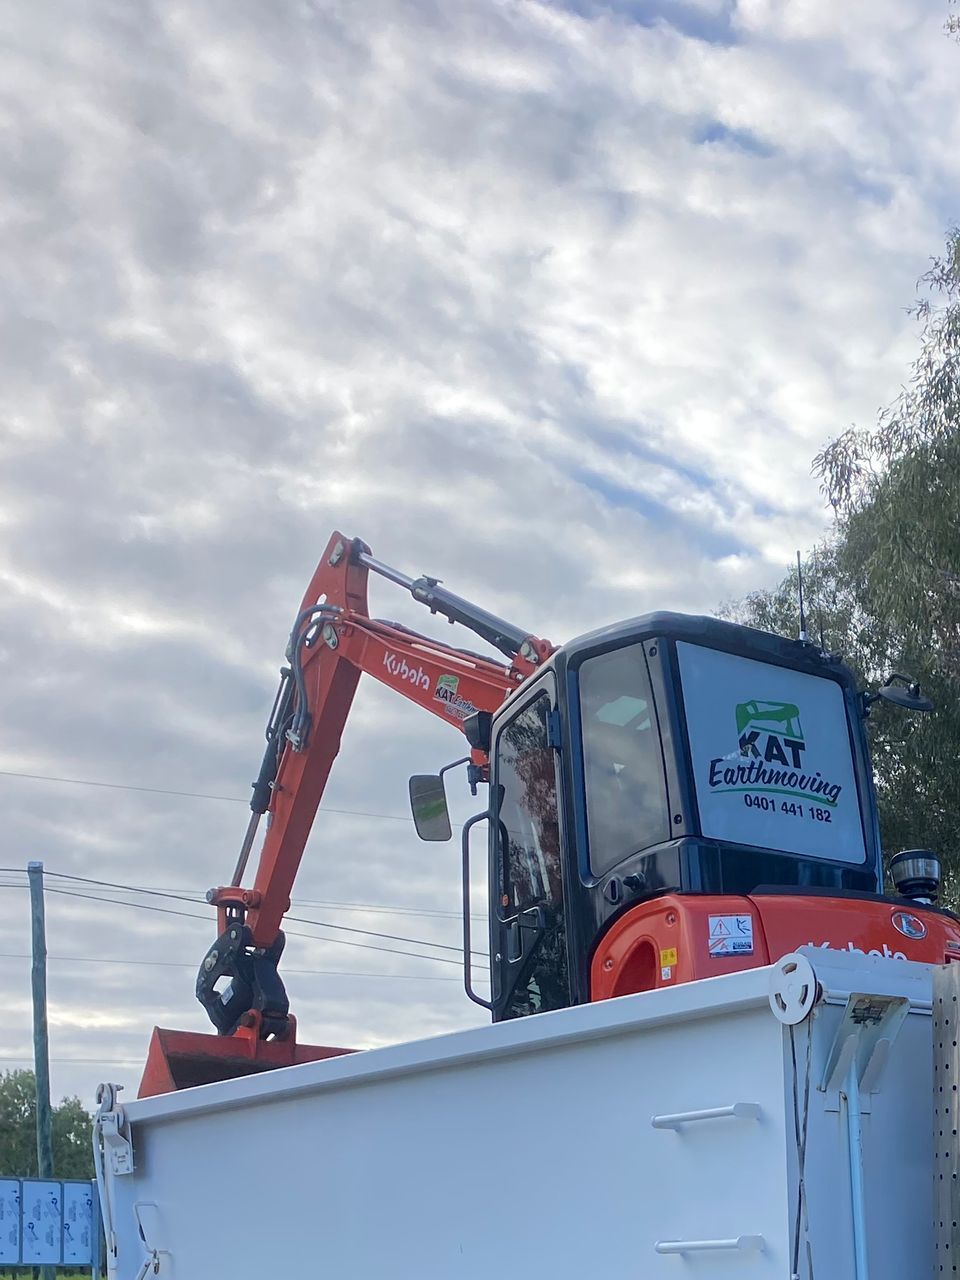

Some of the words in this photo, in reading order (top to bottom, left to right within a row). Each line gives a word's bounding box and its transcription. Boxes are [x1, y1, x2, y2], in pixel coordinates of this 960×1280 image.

[383, 651, 430, 691] Kubota
[435, 686, 455, 703] KAT
[738, 730, 806, 770] KAT
[708, 758, 843, 803] Earthmoving
[744, 793, 776, 812] 0401
[781, 800, 804, 818] 441
[809, 806, 832, 823] 182
